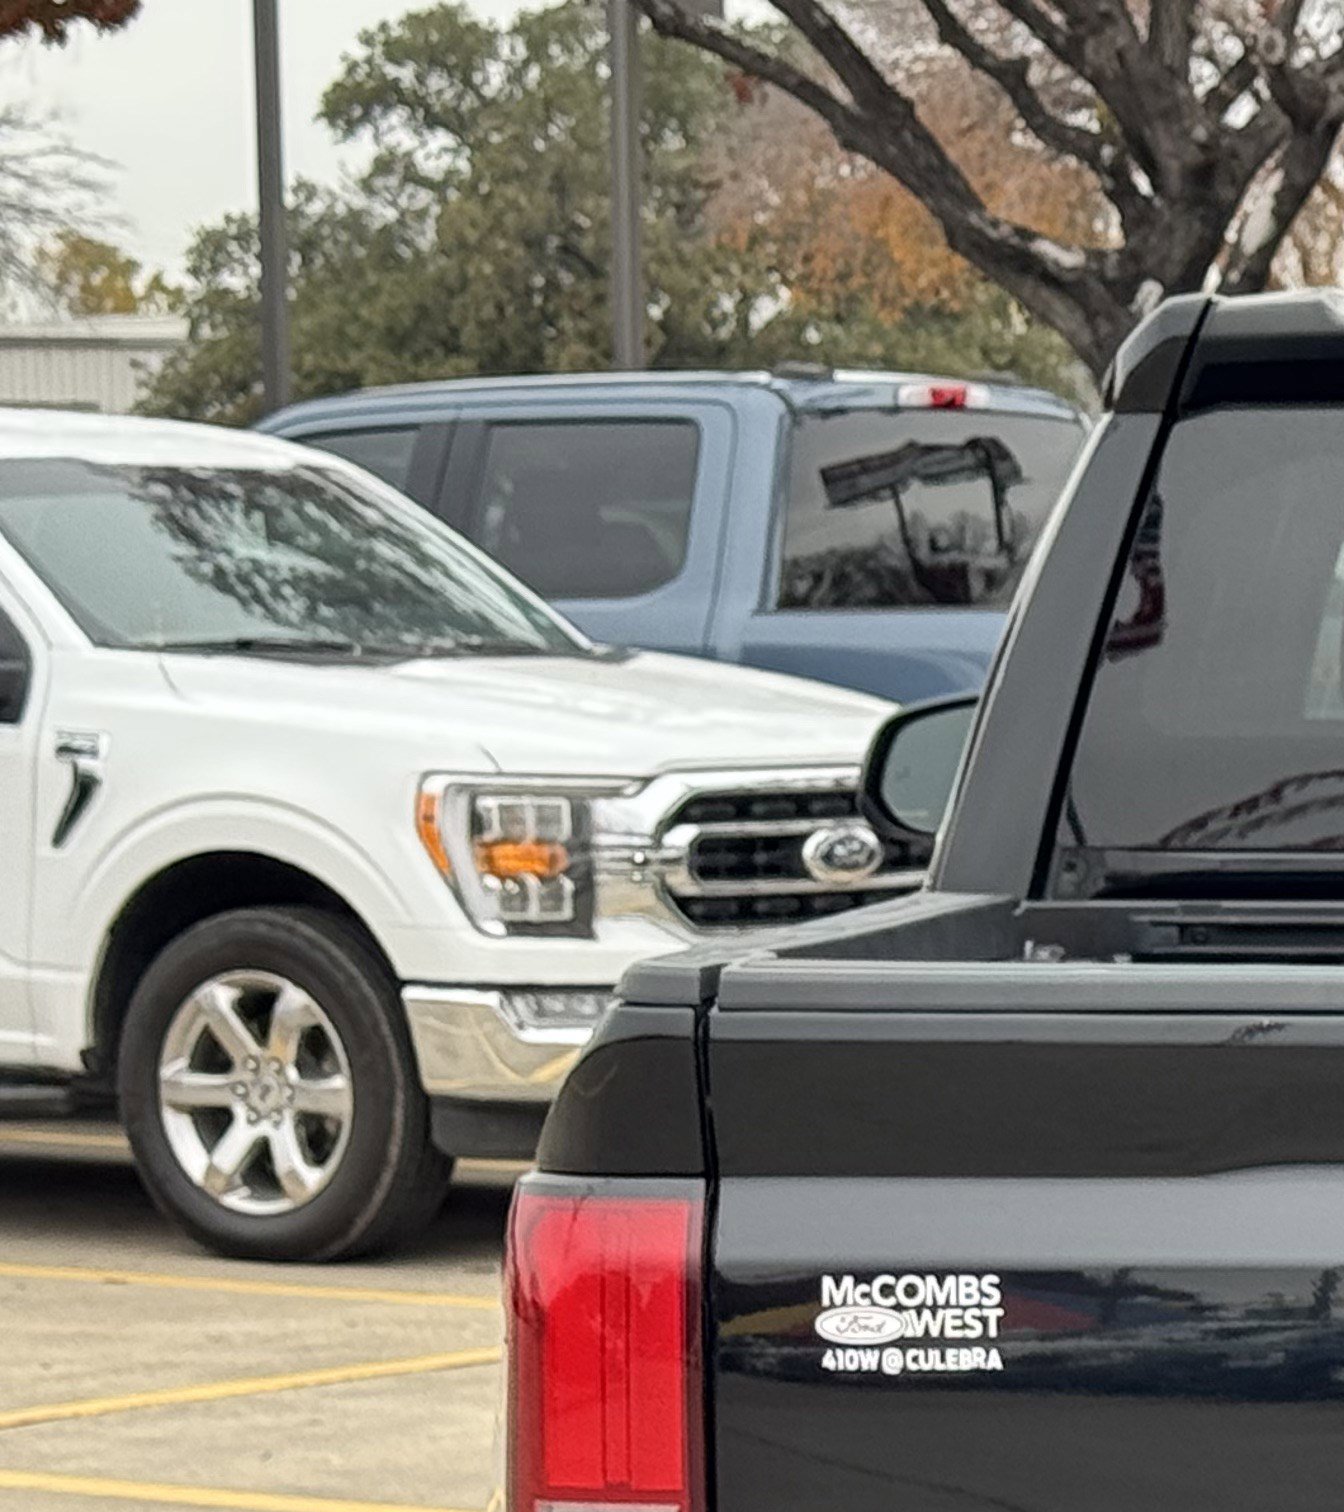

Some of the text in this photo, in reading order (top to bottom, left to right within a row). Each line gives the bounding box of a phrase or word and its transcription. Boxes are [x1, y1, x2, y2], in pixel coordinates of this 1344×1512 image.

[822, 1274, 1001, 1307] McCOMBS
[908, 1308, 1004, 1338] WEST
[905, 1347, 1003, 1371] CULEBRA
